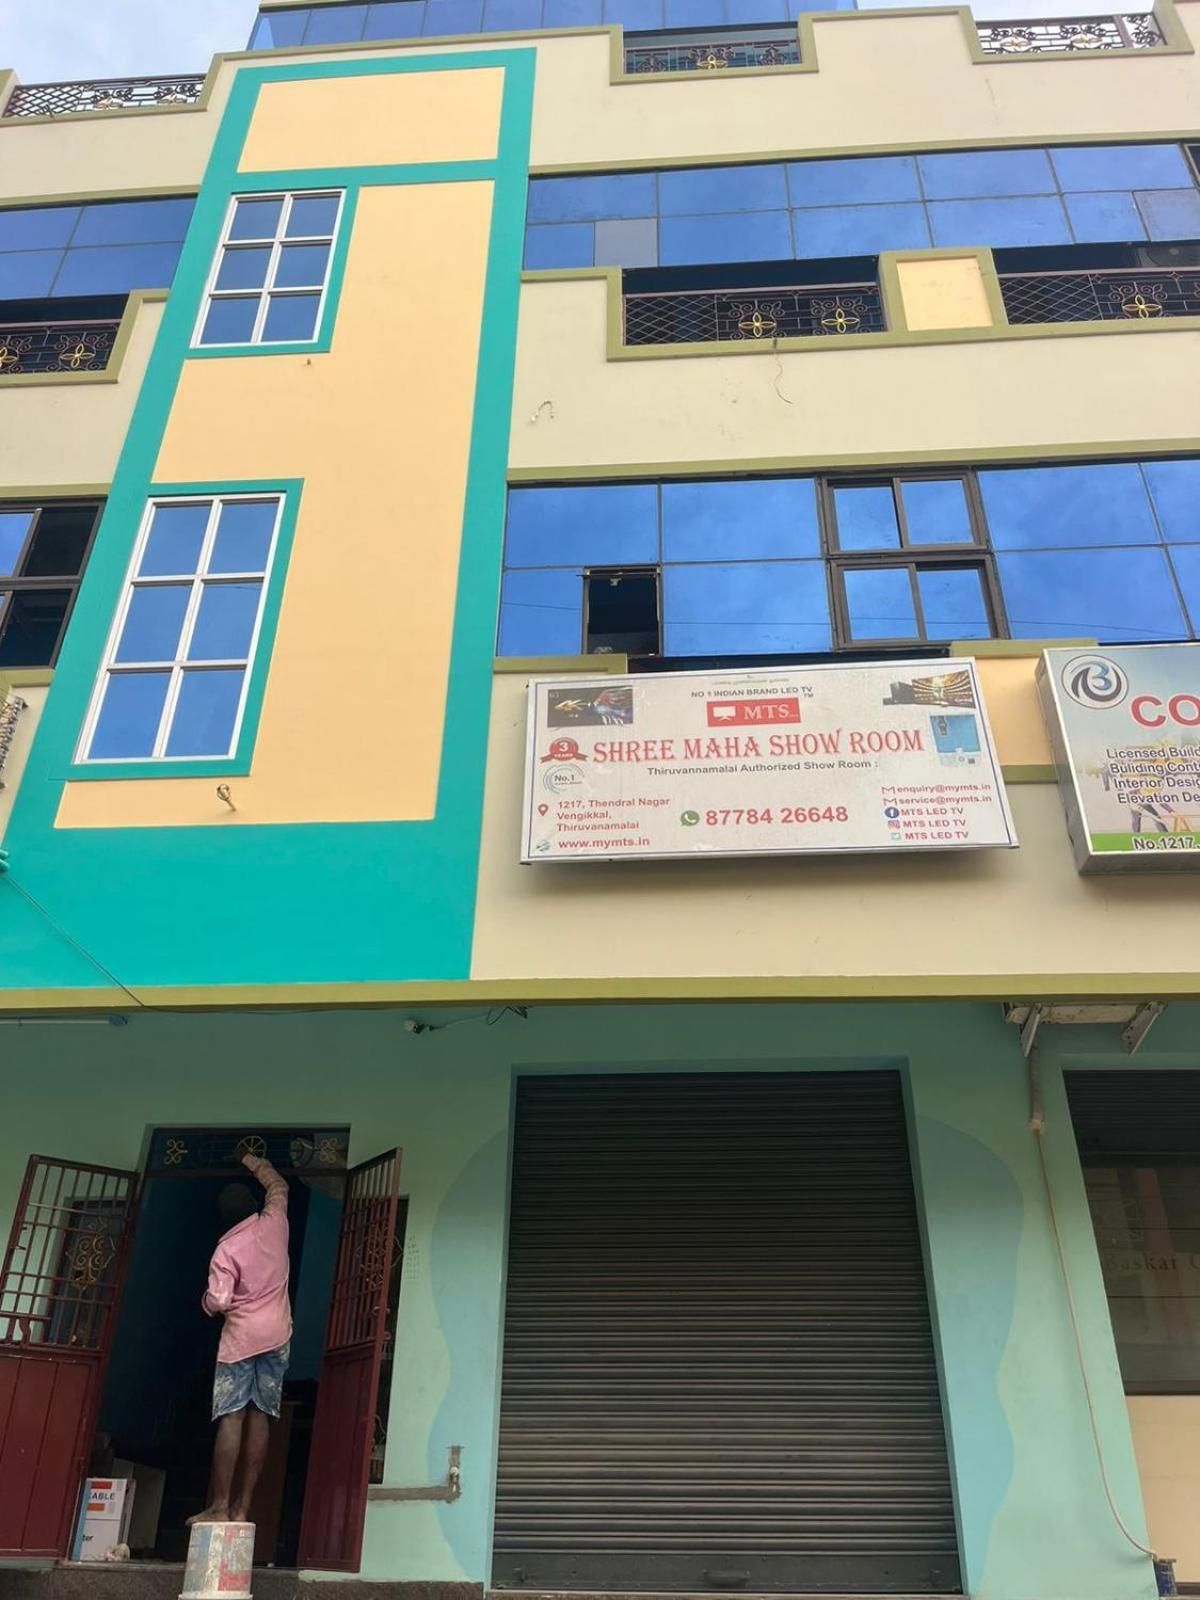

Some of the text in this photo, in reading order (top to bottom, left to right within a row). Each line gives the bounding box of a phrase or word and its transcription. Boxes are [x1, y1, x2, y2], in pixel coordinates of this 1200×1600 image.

[743, 704, 790, 720] MTS
[1131, 694, 1200, 727] CO
[559, 741, 569, 752] 3
[593, 728, 925, 763] SHREE MAHA SHOW ROOM
[1106, 748, 1166, 759] Licensed
[647, 765, 738, 776] Thiruvannamalai
[740, 762, 801, 773] Authorized
[803, 761, 835, 770] Show
[838, 760, 872, 769] Room
[897, 783, 992, 794] enquiry@mymts.in
[1114, 778, 1162, 789] Interior
[589, 799, 636, 808] Thendral
[638, 798, 671, 808] Nagar
[899, 795, 993, 805] service@mymts.in
[1117, 792, 1180, 804] Elevation
[557, 810, 612, 821] Vengikkal,
[705, 806, 849, 826] 87784 26648
[901, 808, 924, 816] MTS
[951, 807, 964, 815] TV
[556, 821, 640, 832] Thiruvanamalai
[903, 820, 926, 828] MTS
[953, 819, 967, 827] TV
[905, 832, 928, 840] MTS
[956, 831, 969, 839] TV
[558, 836, 650, 850] www.mymts.in
